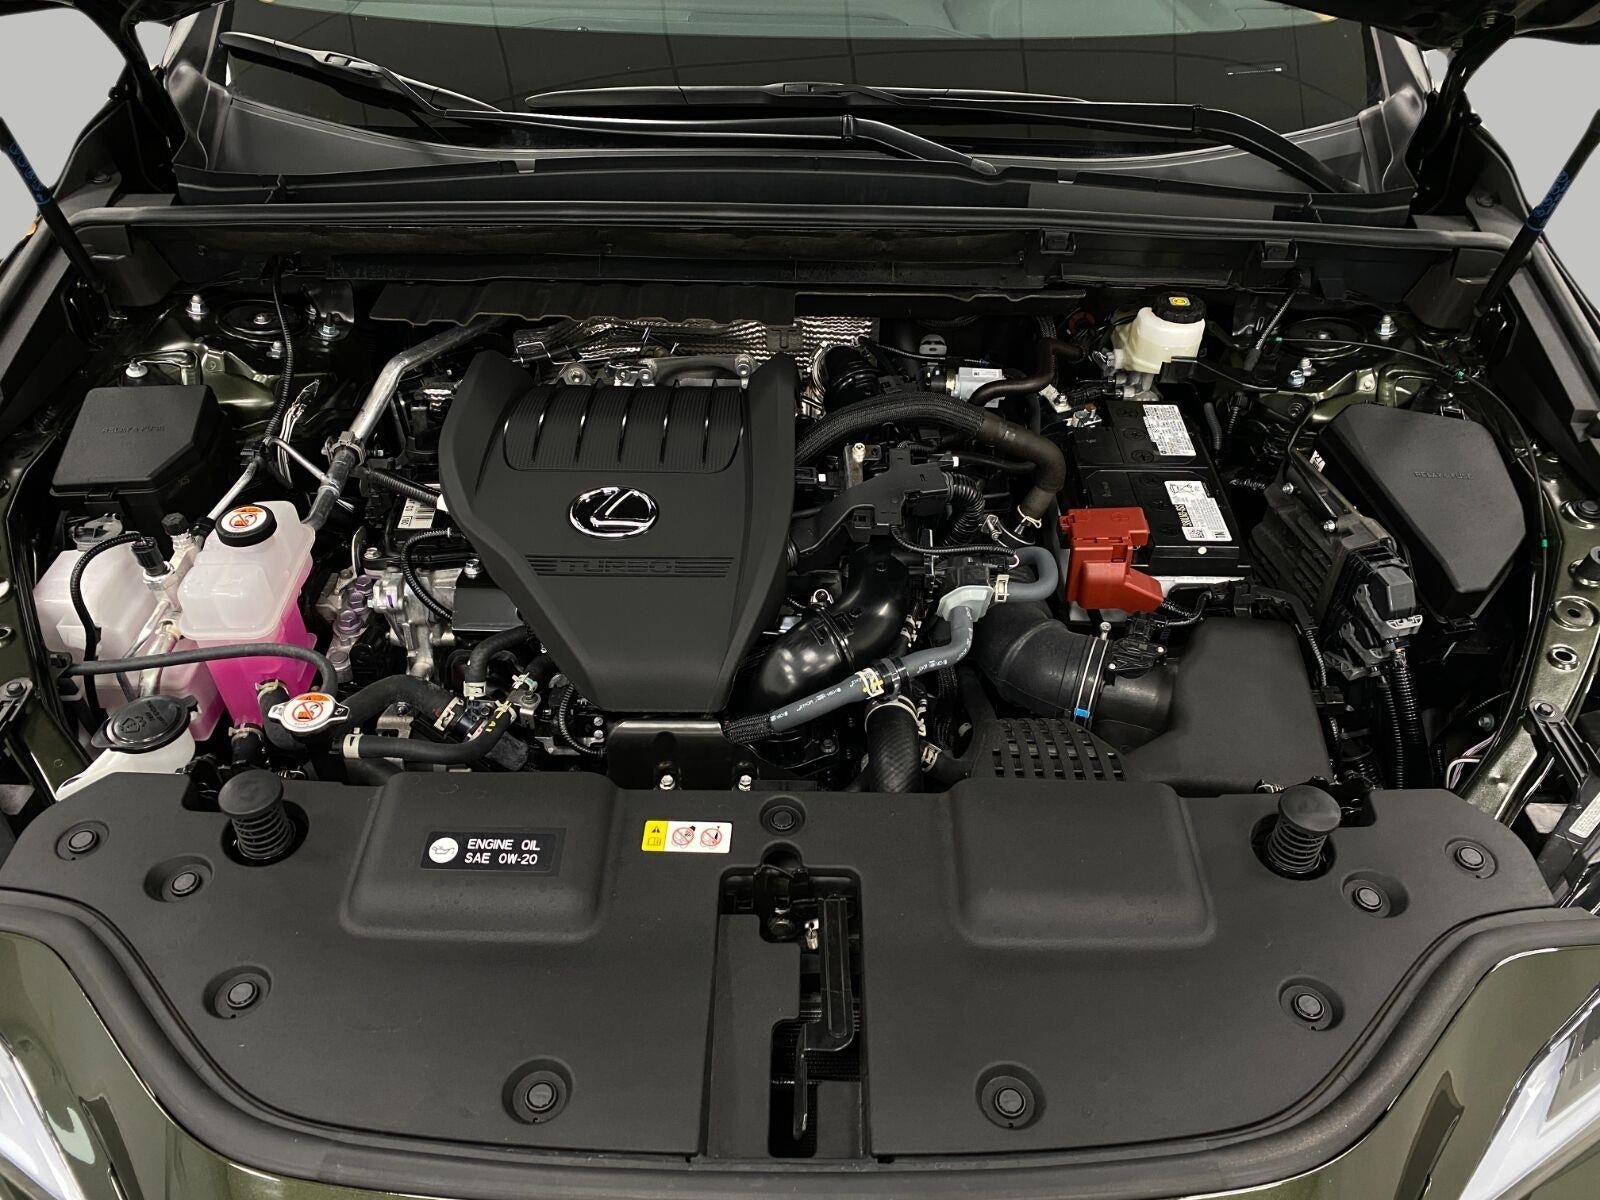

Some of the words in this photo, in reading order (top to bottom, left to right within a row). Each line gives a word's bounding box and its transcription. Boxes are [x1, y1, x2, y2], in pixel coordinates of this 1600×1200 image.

[560, 560, 673, 573] TURBO
[467, 838, 514, 850] ENGINE
[521, 840, 541, 851] OIL
[464, 853, 491, 864] SAE
[498, 853, 538, 865] 0W-20
